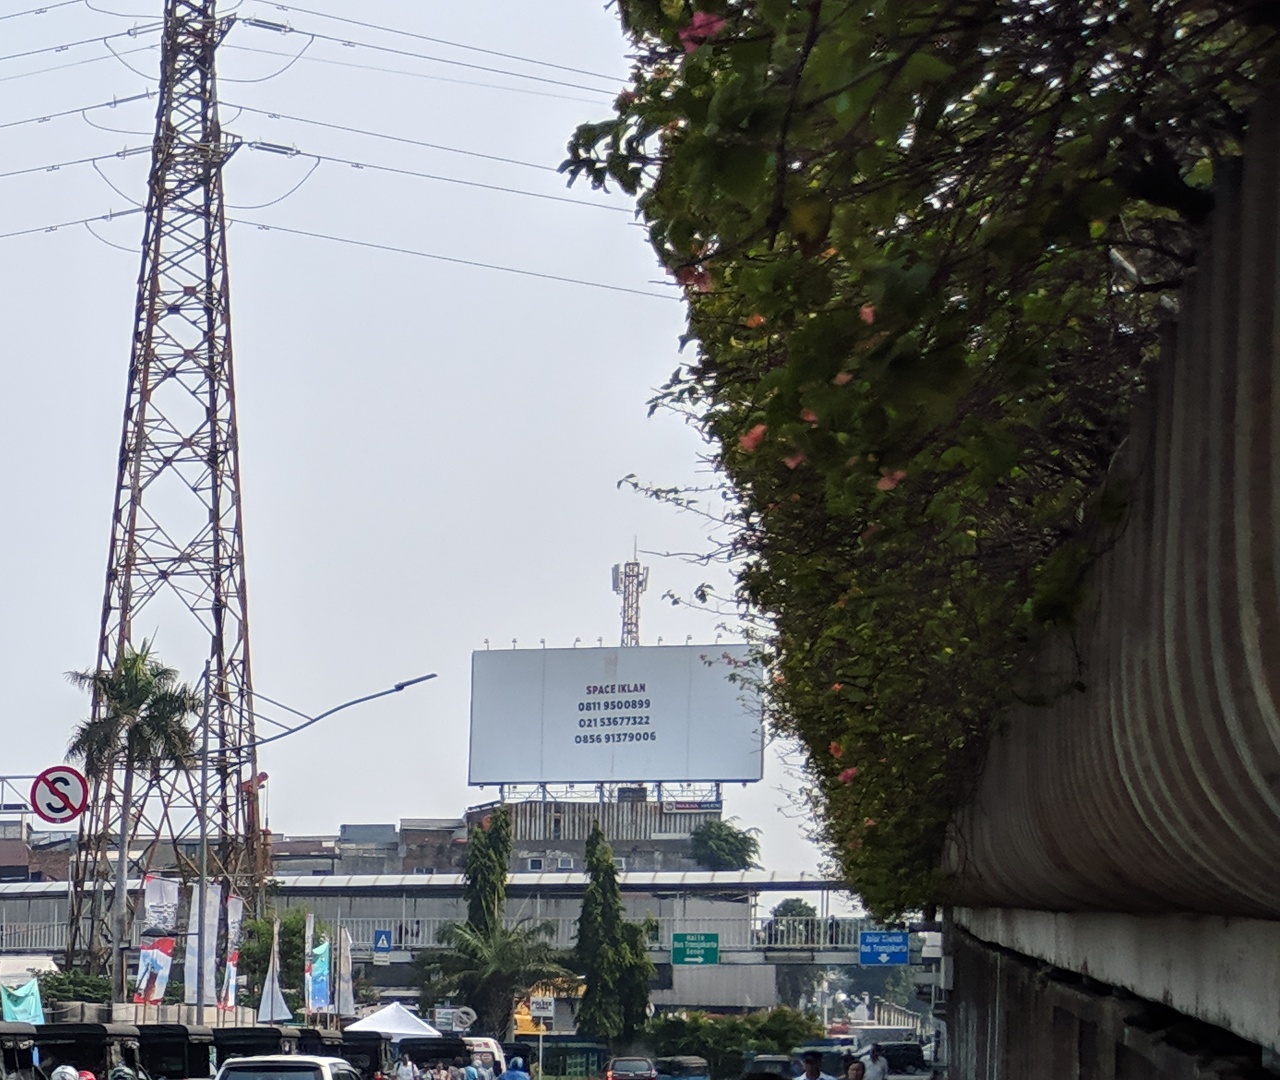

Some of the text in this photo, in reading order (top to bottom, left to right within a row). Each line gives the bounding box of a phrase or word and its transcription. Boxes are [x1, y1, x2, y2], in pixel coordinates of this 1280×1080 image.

[586, 683, 646, 695] SPACE IKLAN
[578, 699, 651, 711] 0811 9500899
[578, 716, 650, 728] 021 53677322
[574, 731, 656, 744] 0856 91379006
